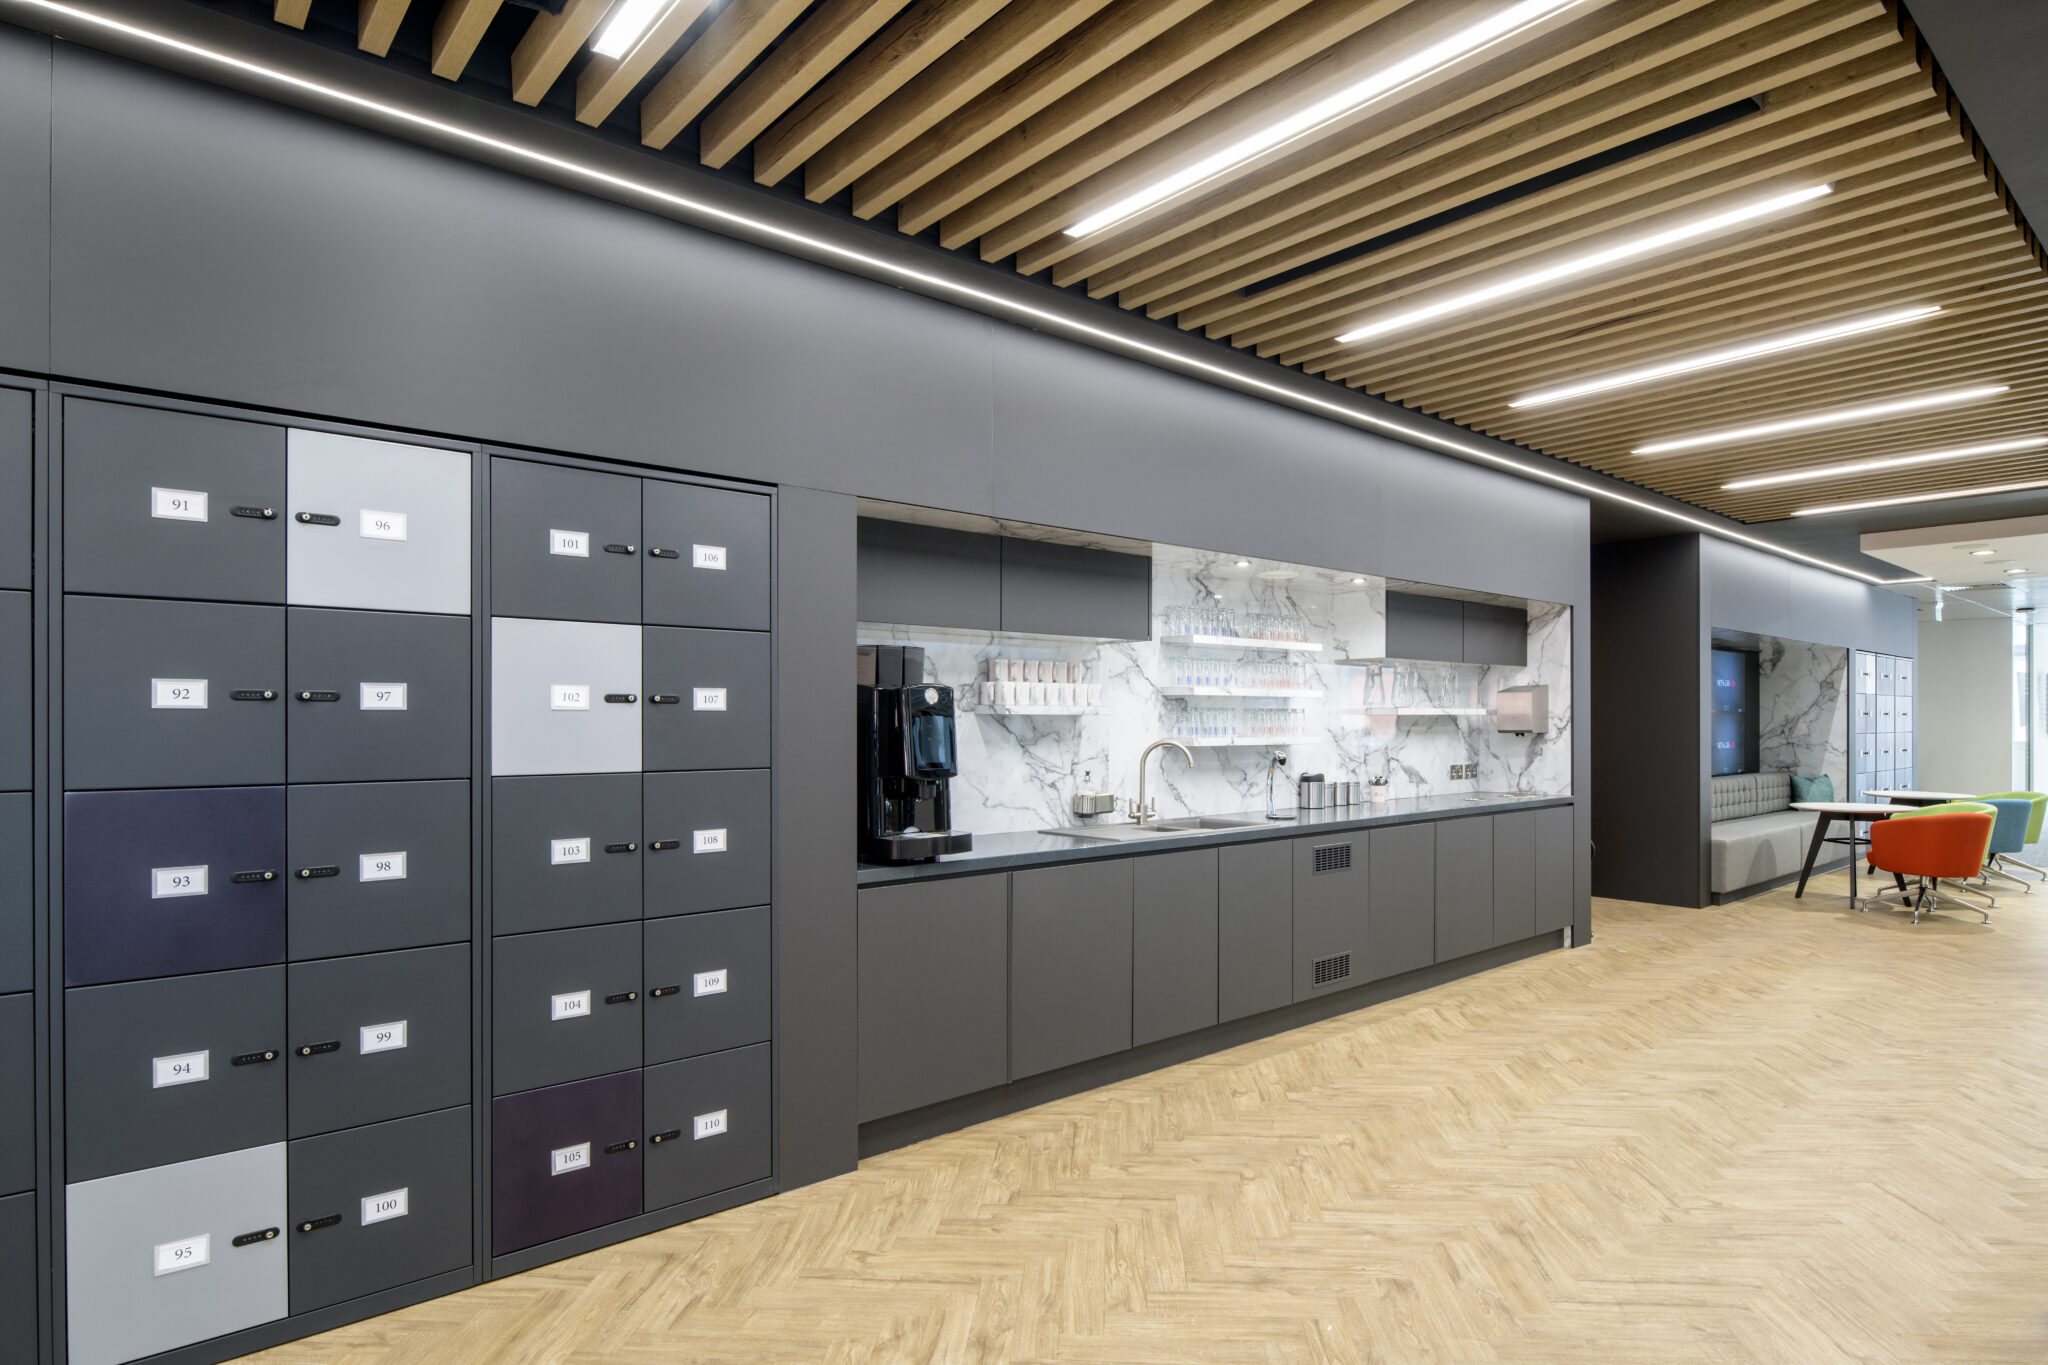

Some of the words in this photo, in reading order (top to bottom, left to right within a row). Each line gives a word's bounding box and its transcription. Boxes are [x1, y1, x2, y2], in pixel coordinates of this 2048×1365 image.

[172, 499, 188, 511] 91
[375, 520, 391, 531] 96
[563, 539, 578, 549] 101
[704, 553, 719, 562] 106
[172, 688, 189, 699] 92
[376, 691, 391, 701] 97
[563, 692, 580, 701] 102
[704, 695, 719, 704] 107
[704, 836, 718, 845] 108
[563, 845, 580, 856] 103
[376, 861, 391, 871] 98
[173, 876, 190, 887] 93
[704, 977, 720, 987] 109
[564, 1000, 581, 1011] 104
[376, 1032, 391, 1043] 99
[173, 1063, 190, 1075] 94
[705, 1119, 720, 1130] 110
[564, 1151, 581, 1164] 105
[376, 1199, 397, 1213] 100
[175, 1247, 192, 1260] 95
